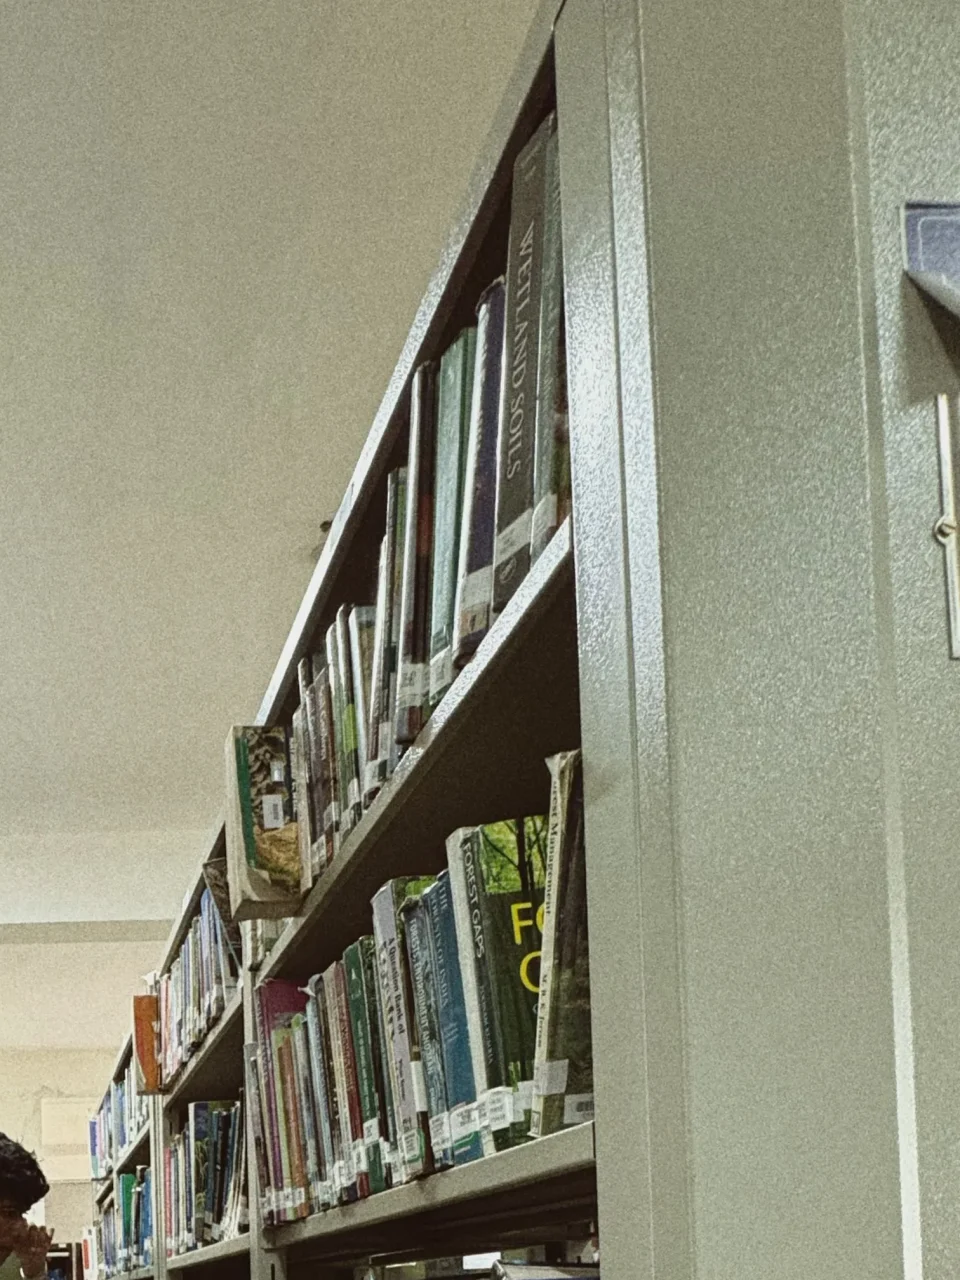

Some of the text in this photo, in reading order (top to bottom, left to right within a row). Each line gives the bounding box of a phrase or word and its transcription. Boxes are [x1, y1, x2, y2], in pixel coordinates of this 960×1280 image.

[506, 220, 535, 480] WETLAND SOILS
[462, 842, 479, 906] FOREST
[471, 909, 486, 958] GAPS
[390, 947, 401, 993] Question
[438, 969, 449, 1007] INDIA
[395, 990, 403, 1021] Bank
[398, 1022, 405, 1034] of
